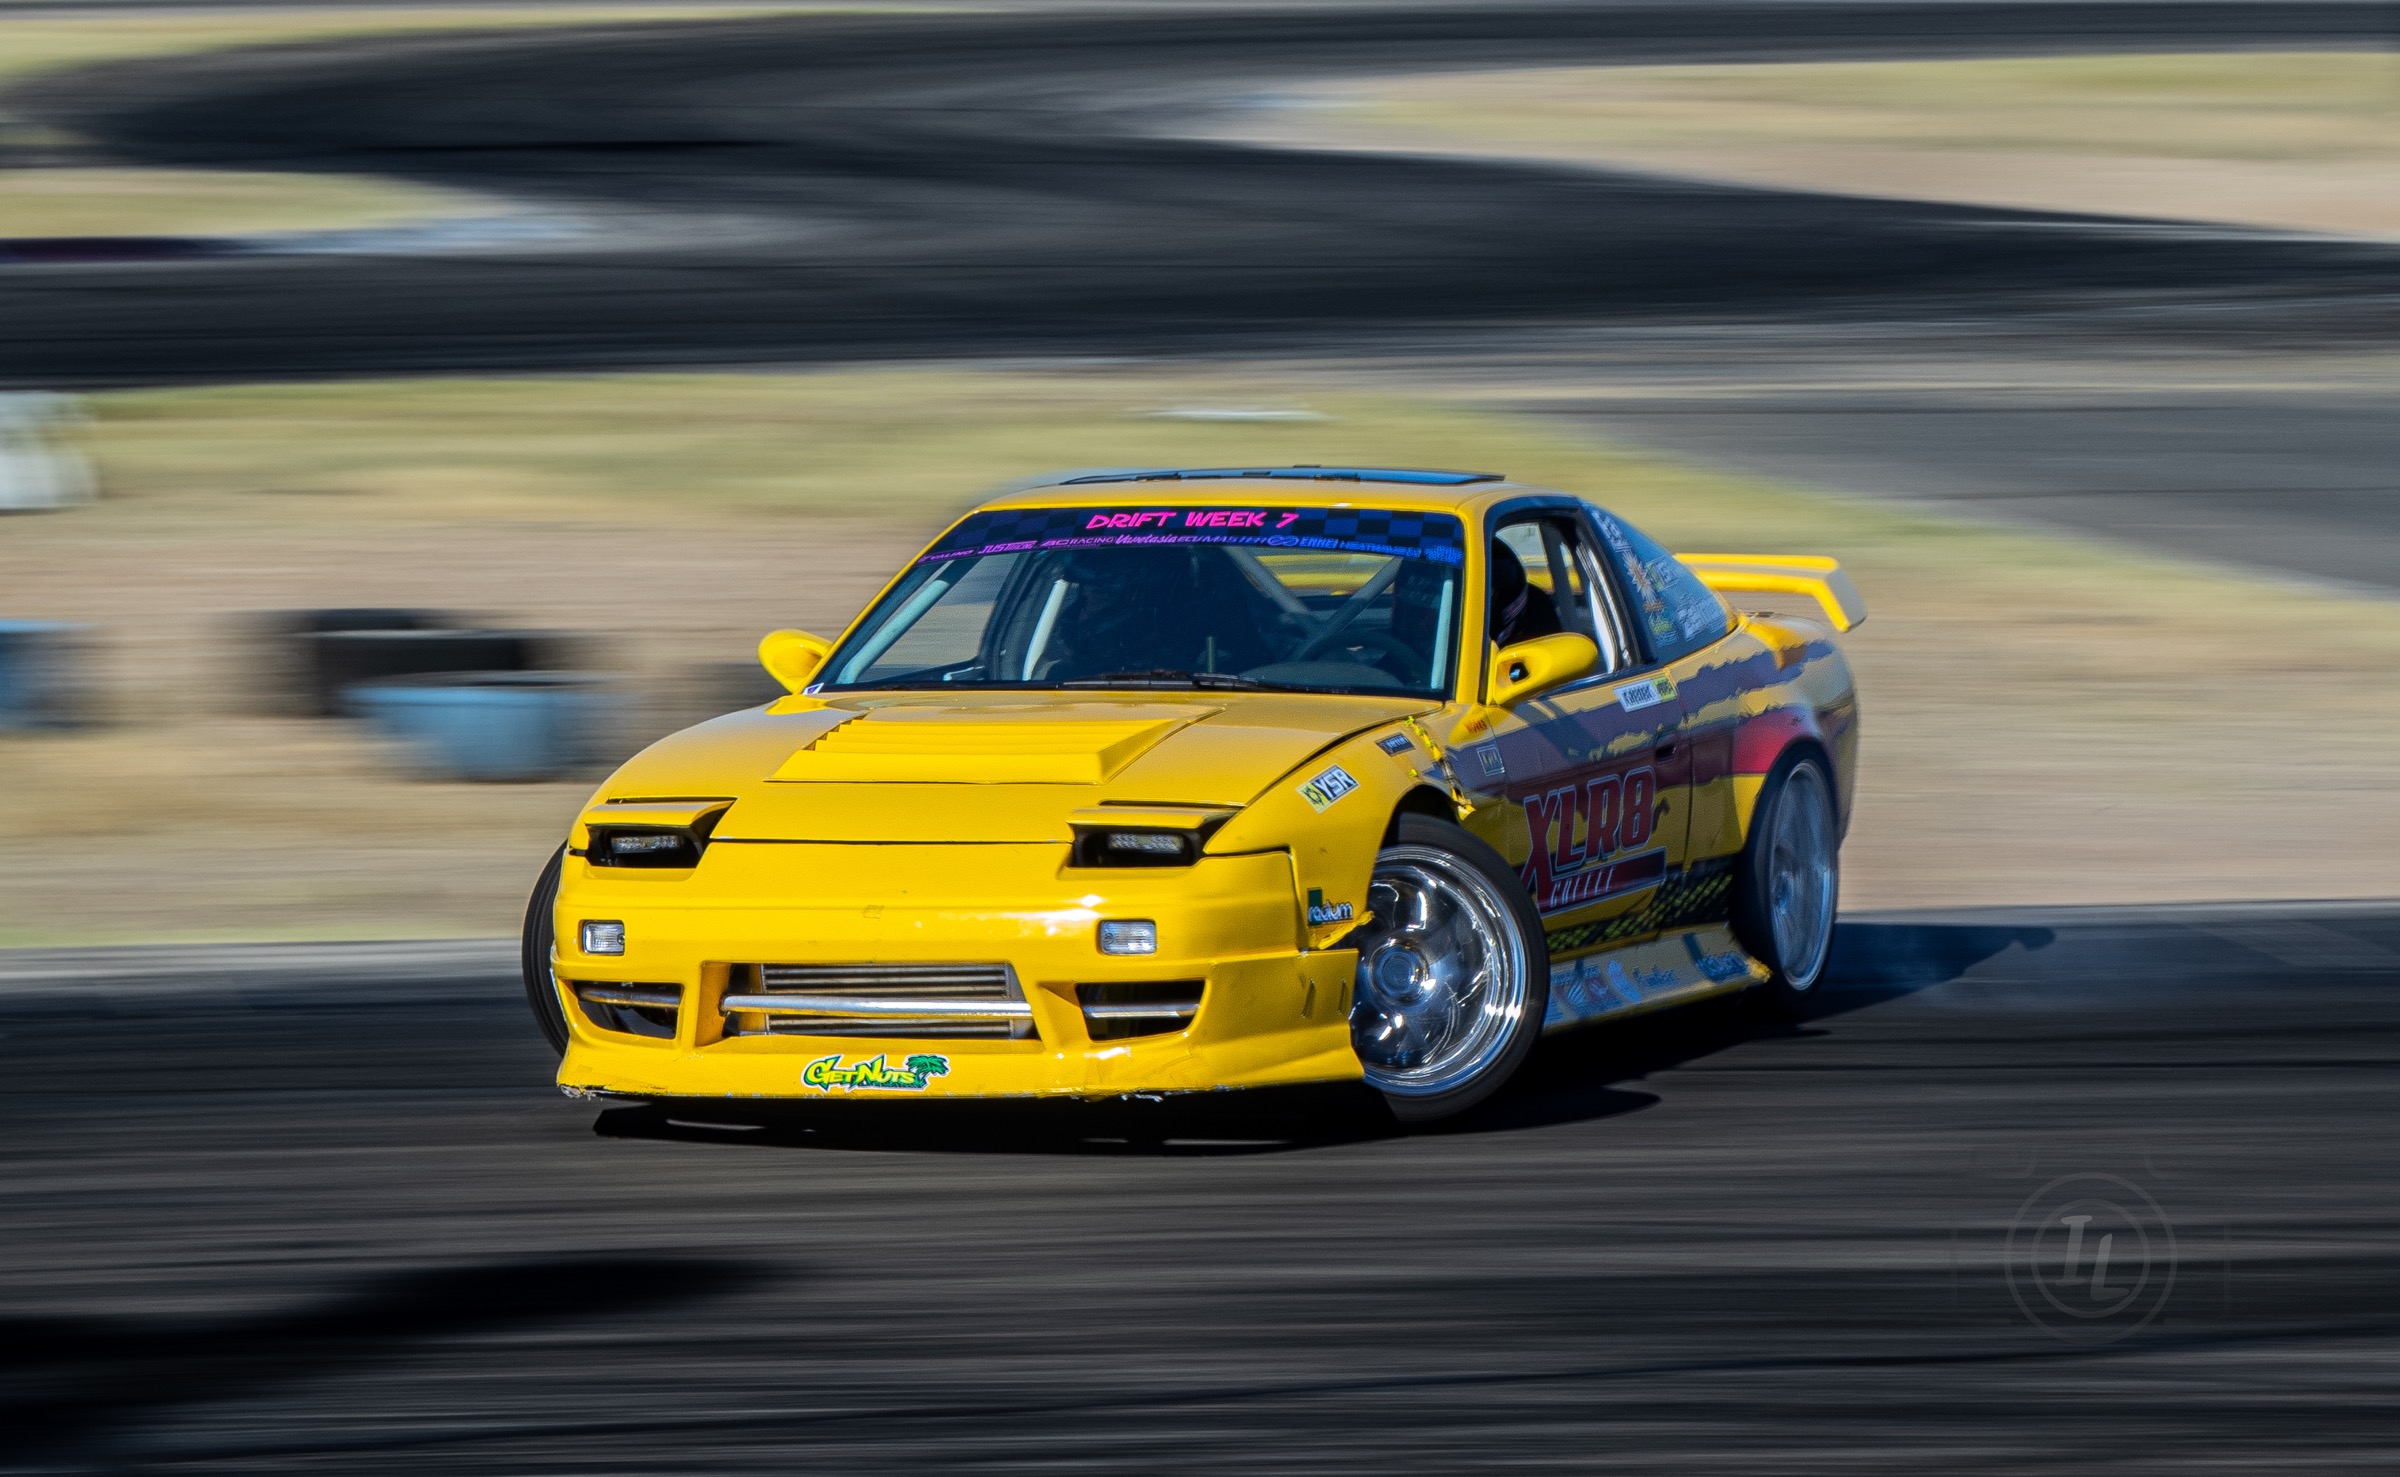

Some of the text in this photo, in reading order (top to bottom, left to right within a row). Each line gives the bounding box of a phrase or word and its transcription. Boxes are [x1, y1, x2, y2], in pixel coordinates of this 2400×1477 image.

[1086, 511, 1300, 529] DRIFT WEEK 7
[1313, 769, 1355, 801] YSR
[1520, 764, 1657, 913] XLR8
